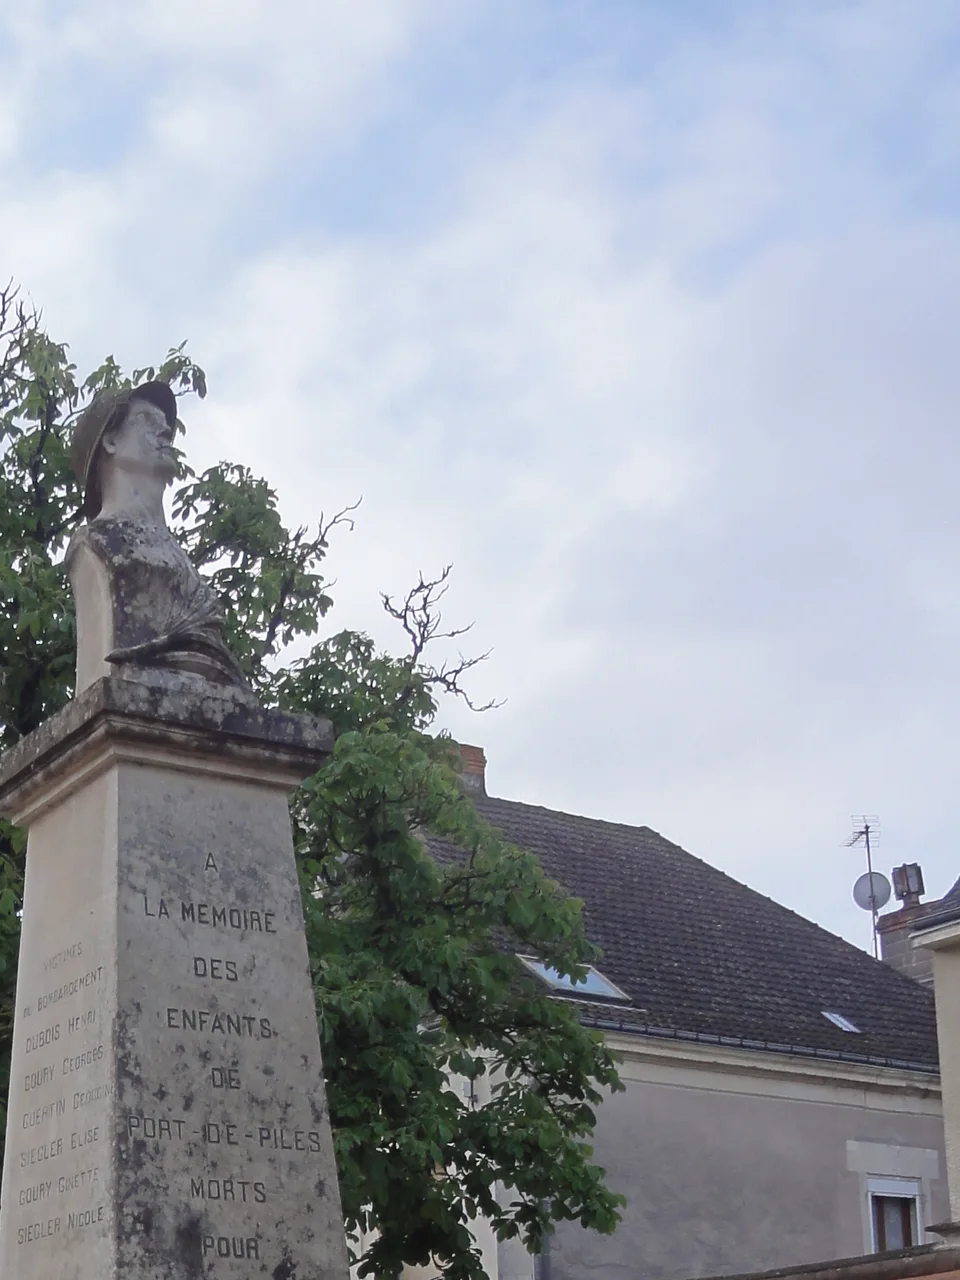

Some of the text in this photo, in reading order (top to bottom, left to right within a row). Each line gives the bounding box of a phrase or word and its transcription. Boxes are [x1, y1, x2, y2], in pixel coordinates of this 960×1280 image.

[205, 852, 218, 873] A
[144, 897, 277, 934] LA MEMOIRE
[43, 942, 83, 972] VICTIMES
[193, 957, 238, 982] DES
[37, 966, 103, 1012] BOMBARDEMENT
[25, 1009, 96, 1054] DUBOIS HENRI
[167, 1008, 272, 1038] ENFANTS
[24, 1045, 103, 1092] GOURY GEORGES
[211, 1067, 240, 1089] DE
[22, 1098, 66, 1129] GUERTIN
[20, 1126, 100, 1168] SIEGLER ELISE
[20, 1167, 99, 1206] GOURY GINETTE
[191, 1178, 267, 1203] MORTS
[17, 1206, 104, 1244] SIEGLER NICOLE
[202, 1235, 260, 1260] POUR
